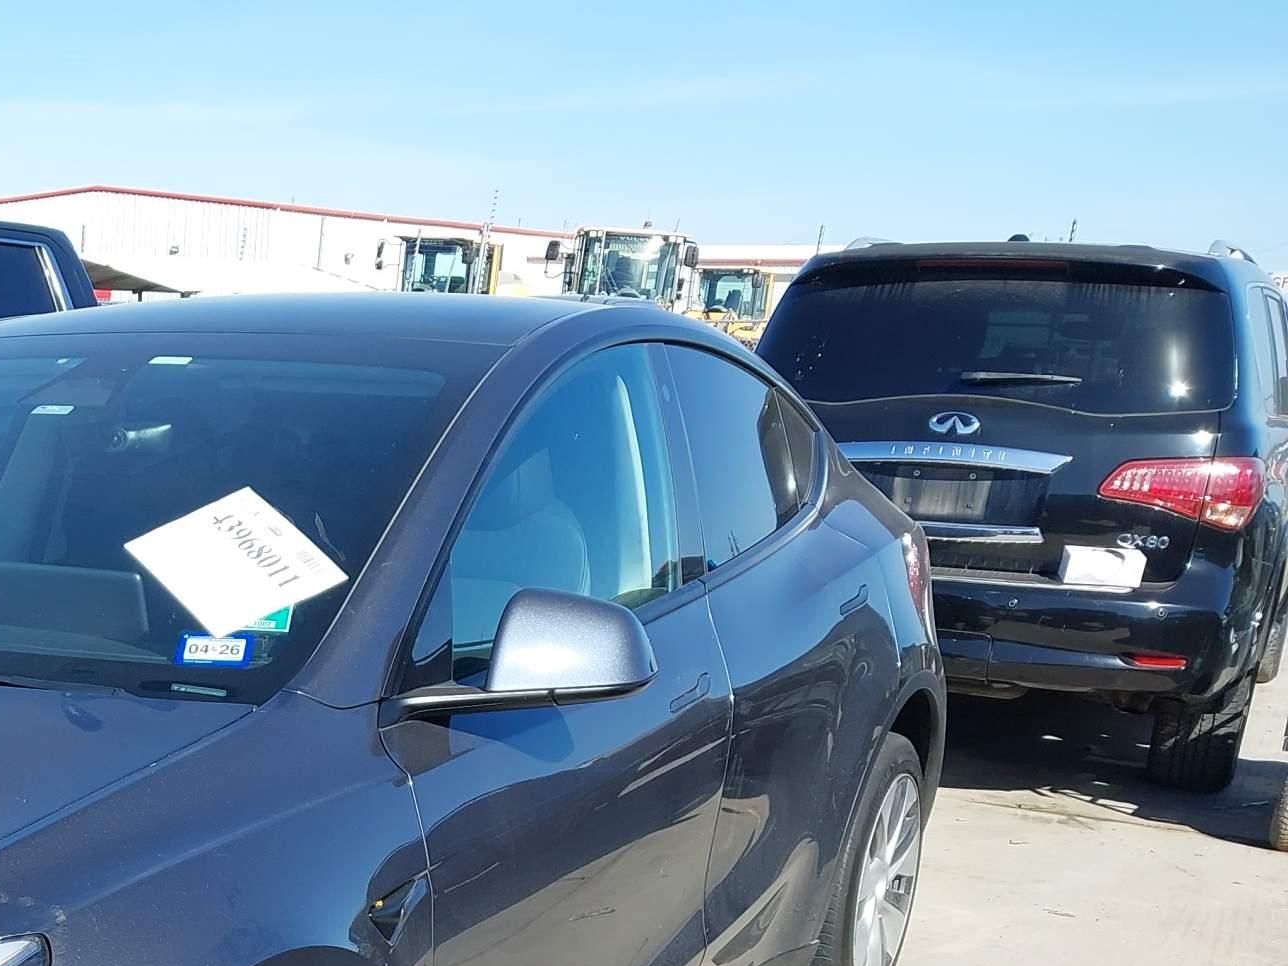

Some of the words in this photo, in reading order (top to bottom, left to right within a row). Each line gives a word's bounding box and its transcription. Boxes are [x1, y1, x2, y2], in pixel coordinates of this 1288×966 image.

[891, 445, 1006, 461] INFINITI
[1117, 533, 1170, 549] QX80
[213, 514, 300, 588] 43968011
